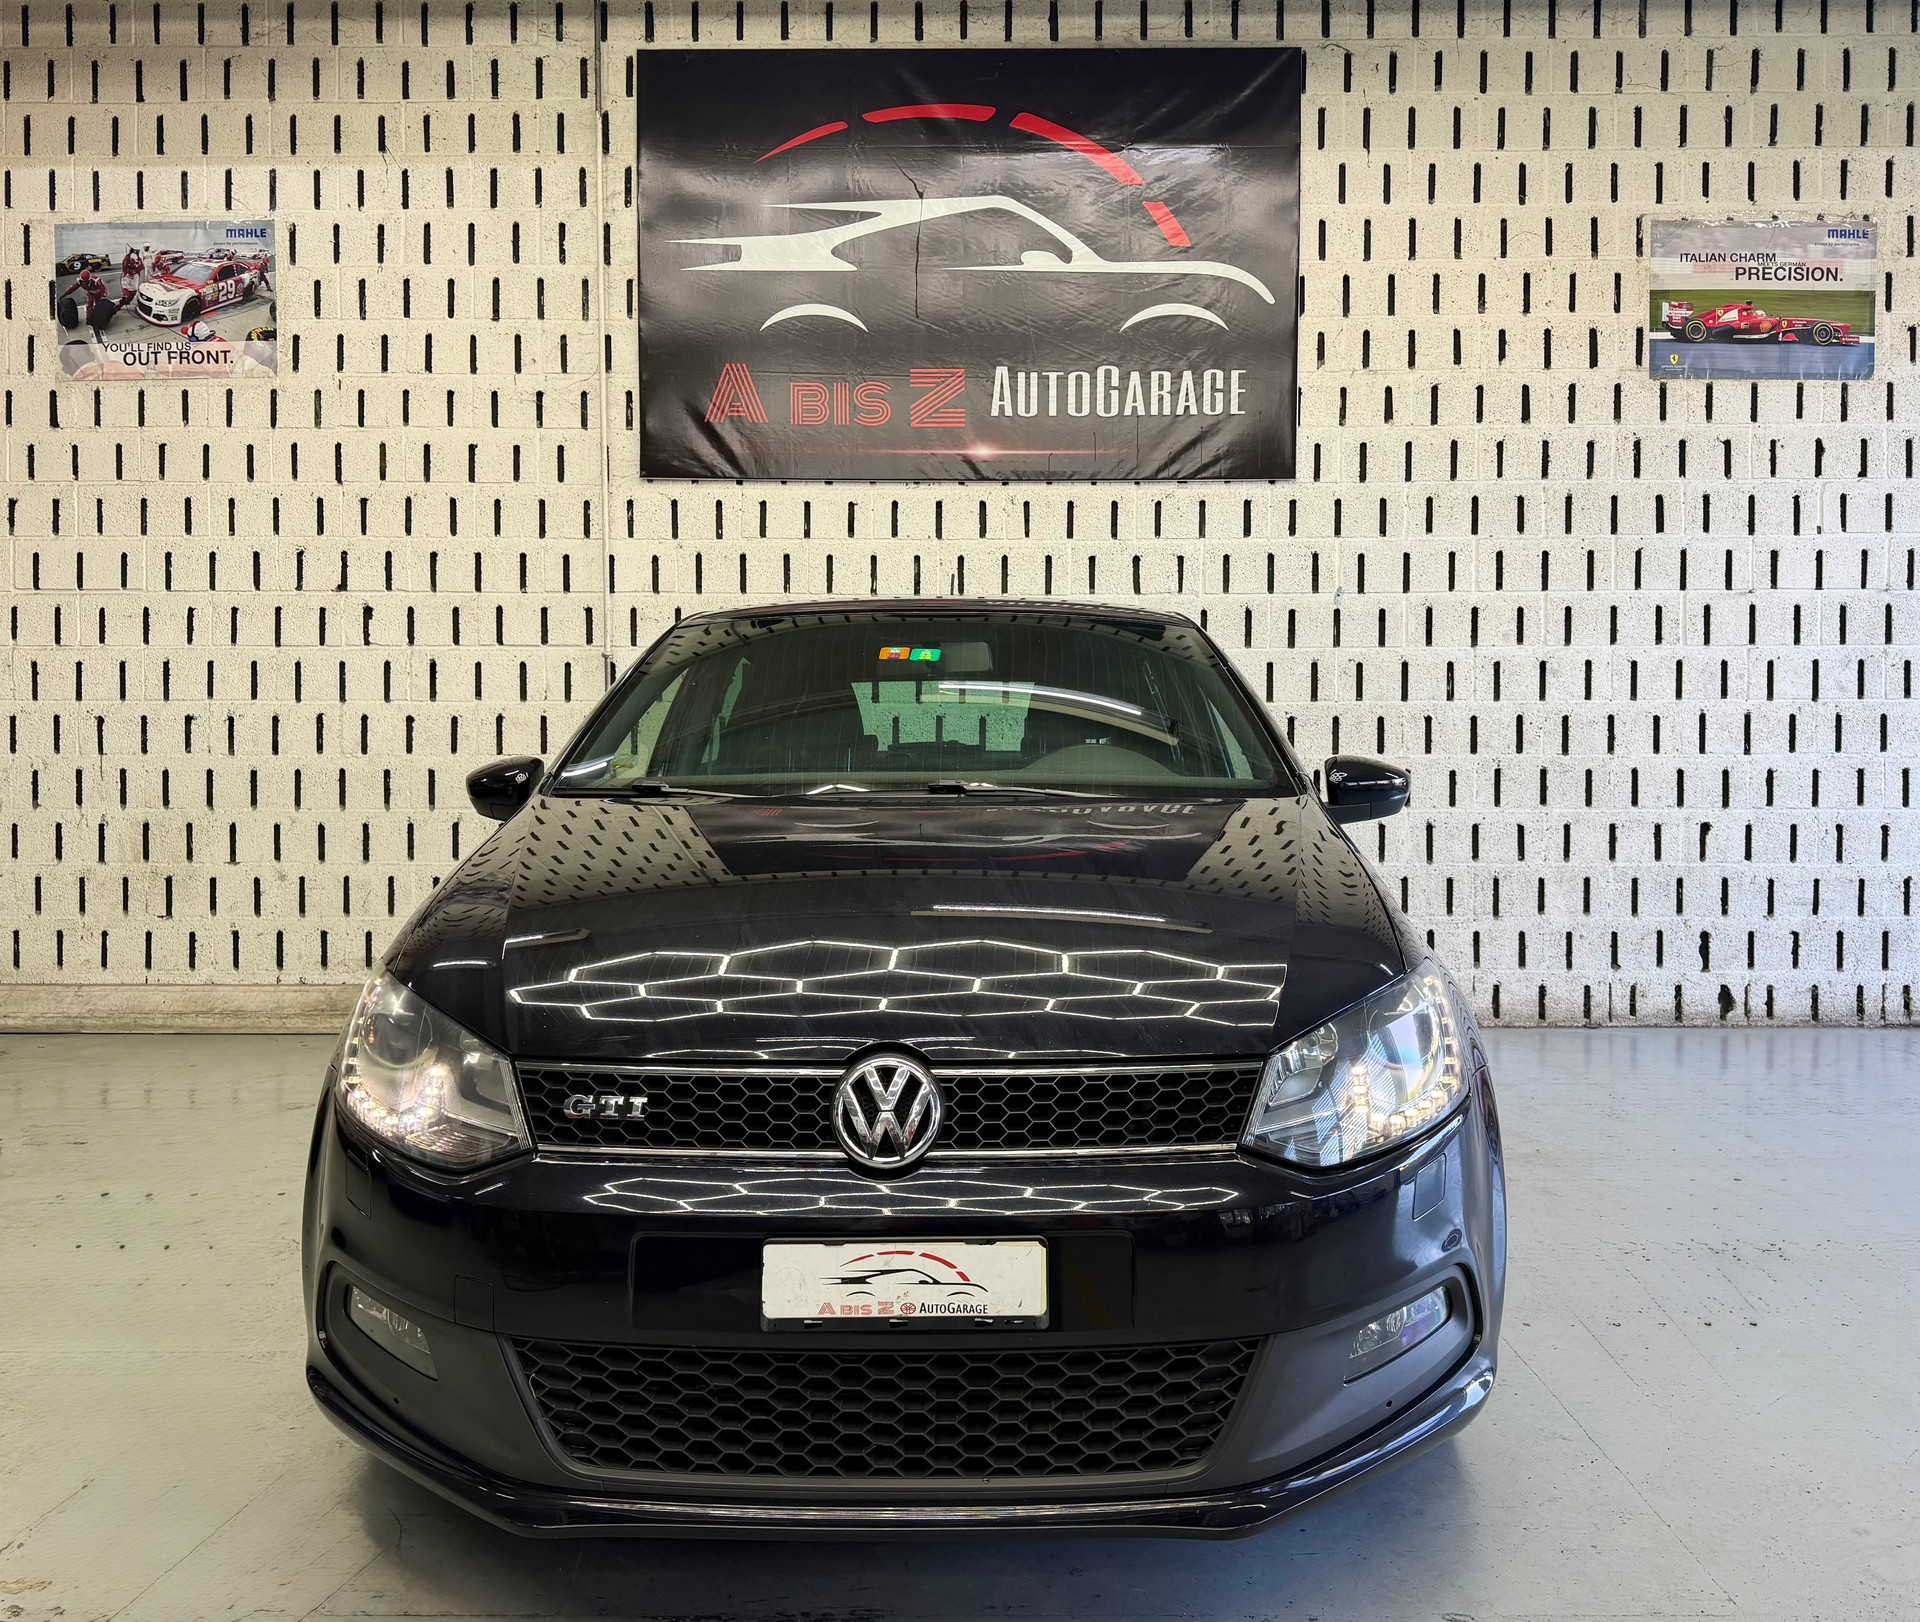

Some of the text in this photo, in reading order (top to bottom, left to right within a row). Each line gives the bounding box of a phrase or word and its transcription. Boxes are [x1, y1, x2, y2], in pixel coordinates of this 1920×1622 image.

[225, 228, 267, 239] MAHLE
[1827, 229, 1869, 239] MAHLE
[1679, 253, 1777, 263] ITALIAN CHARM
[73, 261, 82, 271] 9
[1735, 267, 1844, 282] PRECISION.
[218, 280, 237, 302] 29
[103, 342, 192, 353] YOU'LL FIND US
[123, 350, 234, 366] OUT FRONT.
[704, 363, 769, 424] A
[790, 380, 892, 426] BIS
[909, 368, 966, 428] Z
[563, 1093, 649, 1121] GTI
[817, 1302, 837, 1315] A
[840, 1304, 873, 1315] BIS
[877, 1301, 895, 1314] Z
